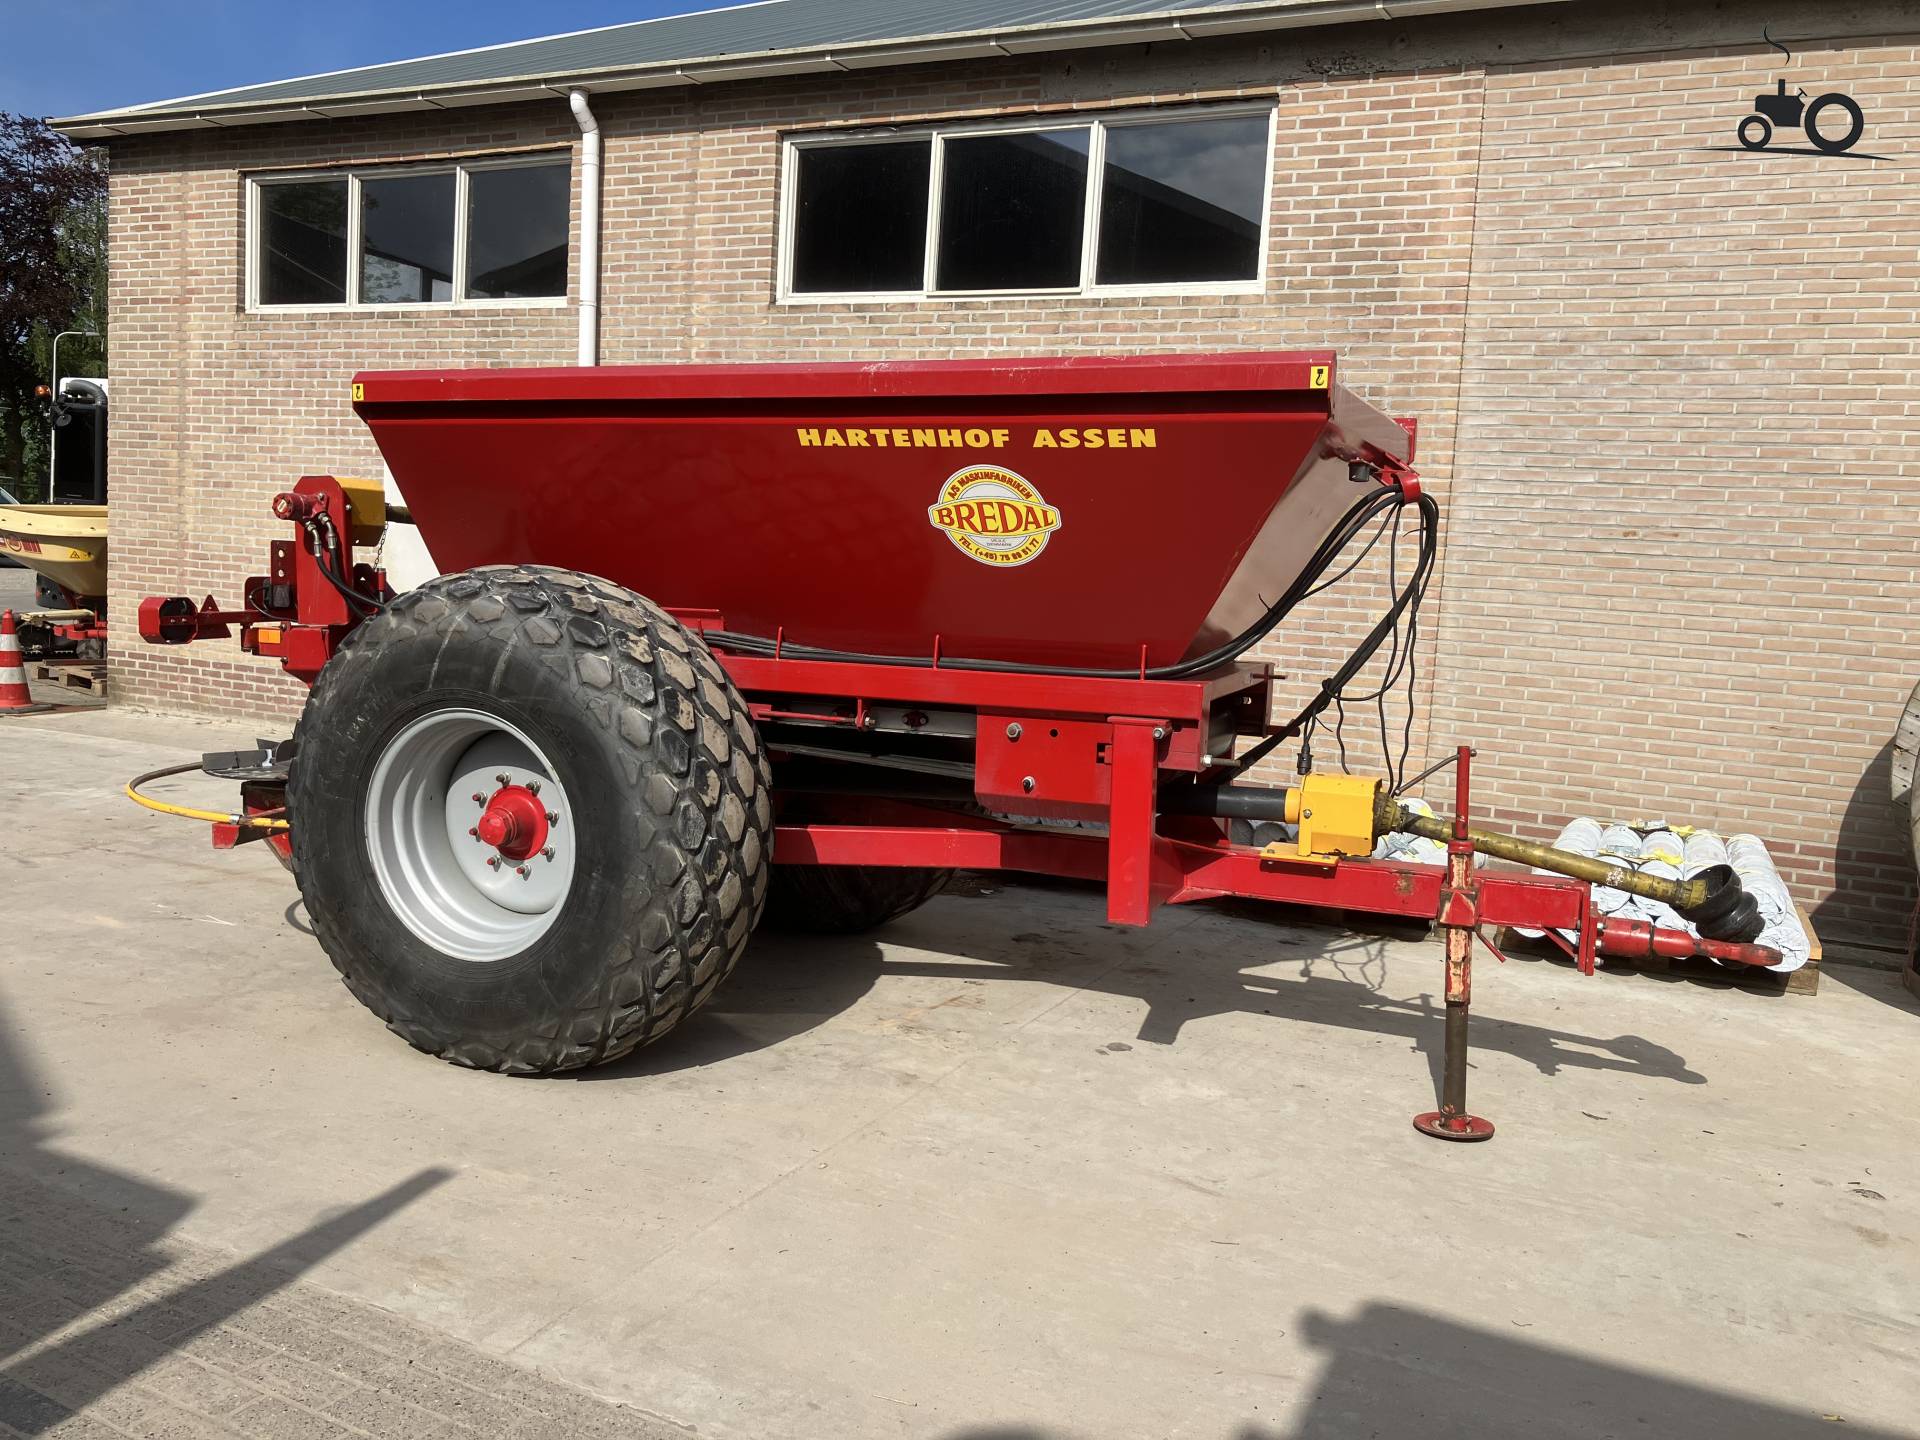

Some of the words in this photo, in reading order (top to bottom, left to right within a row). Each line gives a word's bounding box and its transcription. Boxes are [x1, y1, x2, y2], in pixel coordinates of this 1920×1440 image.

[797, 428, 1010, 448] HARTENHOF
[1032, 428, 1158, 449] ASSEN
[947, 484, 961, 499] A/S
[958, 471, 1034, 500] MASKINFABRIKEN
[935, 501, 1055, 534] BREDAL
[958, 536, 973, 551] TEL.
[1029, 538, 1040, 548] 77
